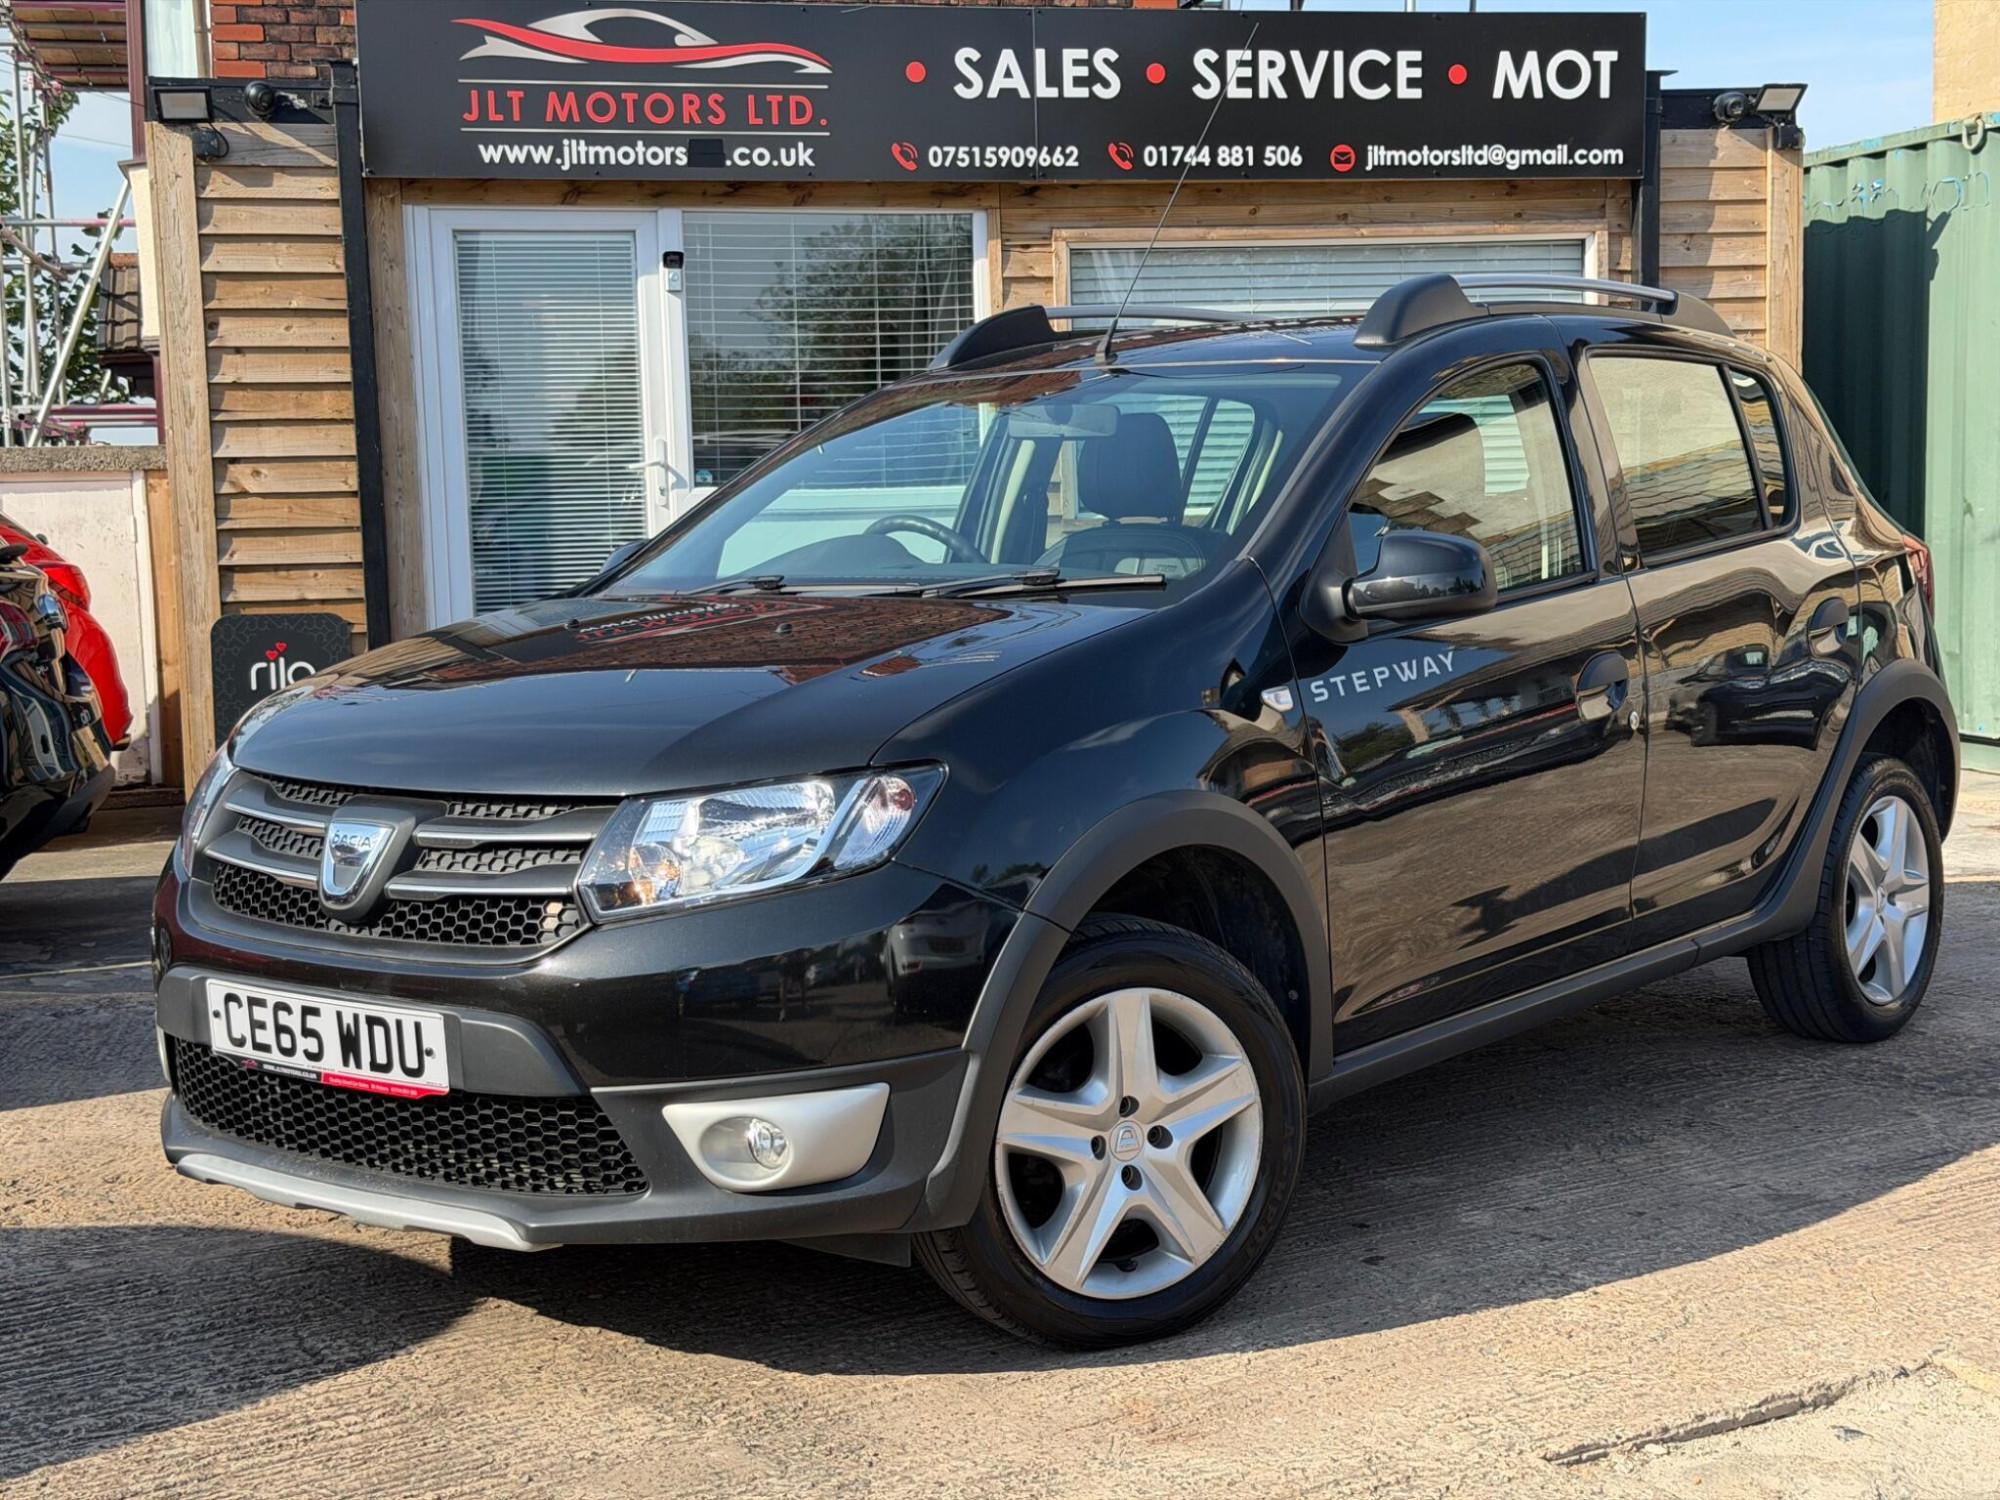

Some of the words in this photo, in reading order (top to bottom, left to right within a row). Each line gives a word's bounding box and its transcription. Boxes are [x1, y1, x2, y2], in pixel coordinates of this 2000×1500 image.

[952, 46, 1122, 100] SALES
[1191, 48, 1423, 100] SERVICE
[1492, 49, 1619, 100] MOT
[462, 89, 525, 122] JLT
[545, 91, 727, 125] MOTORS
[747, 94, 828, 126] LTD.
[927, 145, 1080, 168] 07515909662
[1143, 145, 1211, 167] 01744
[1216, 145, 1255, 167] 881
[1263, 145, 1304, 168] 506
[1365, 144, 1625, 171] jltmotorsltd@gmail.com
[1309, 651, 1455, 703] STEPWAY
[332, 831, 372, 849] DACIA
[223, 992, 324, 1063] CE65
[335, 1010, 425, 1079] WDU
